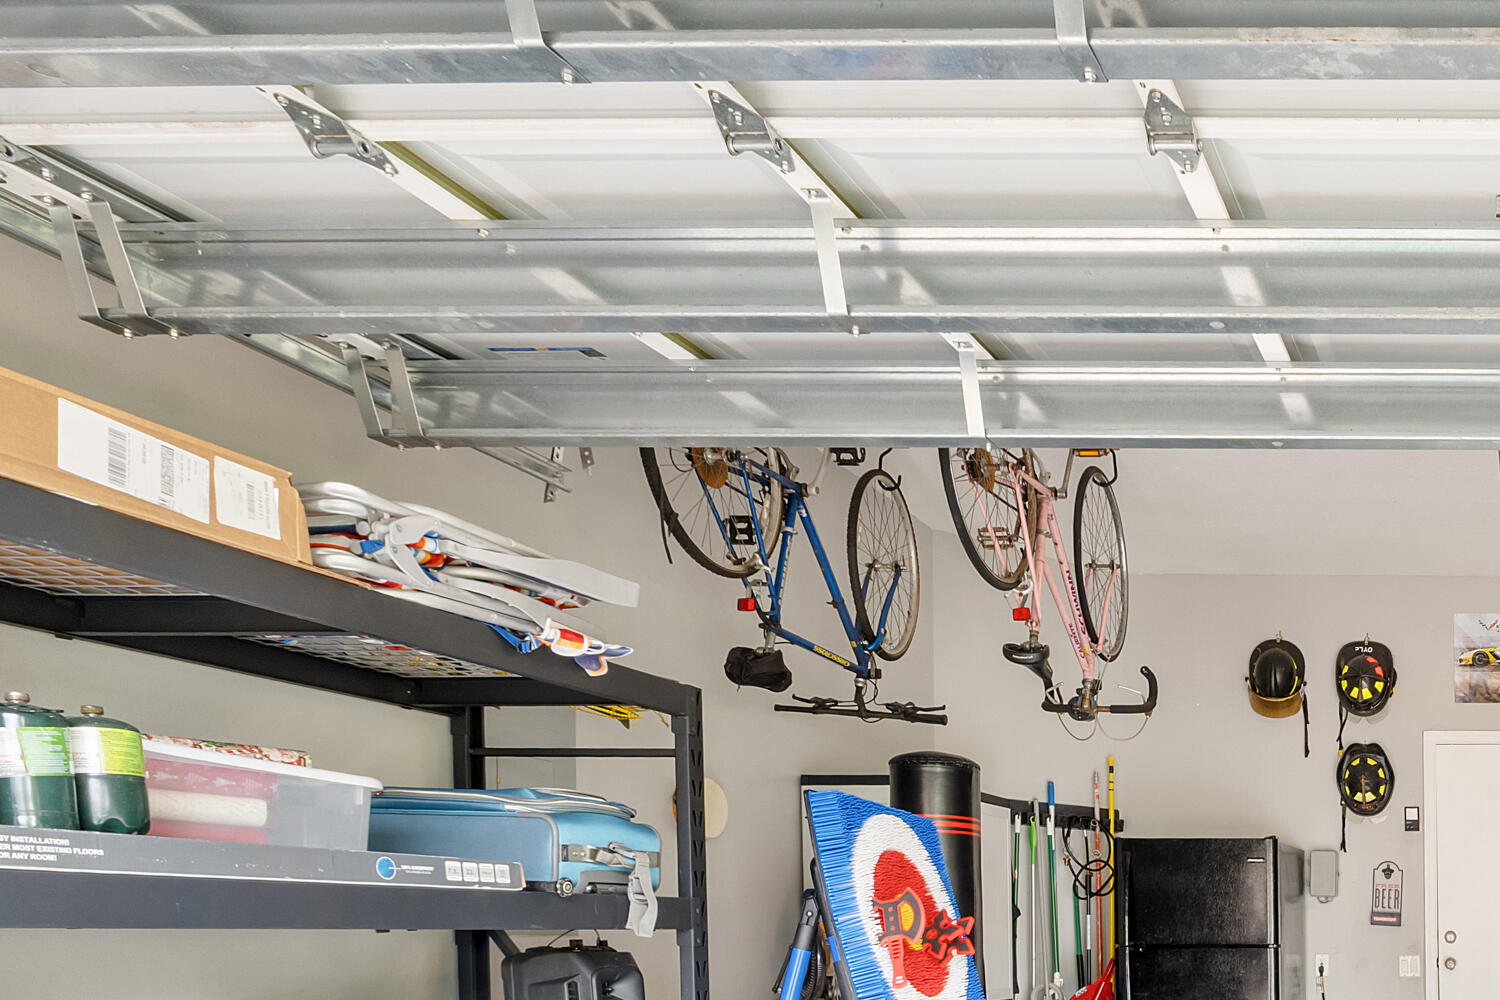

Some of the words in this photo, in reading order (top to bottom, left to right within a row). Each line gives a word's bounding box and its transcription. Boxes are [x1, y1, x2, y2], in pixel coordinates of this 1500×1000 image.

[1065, 569, 1086, 636] SCHWINN
[10, 835, 70, 846] INSTALLATION!
[12, 844, 35, 852] MOST
[36, 845, 72, 854] EXISTING
[73, 848, 104, 856] FLOORS
[1374, 888, 1400, 909] BEER
